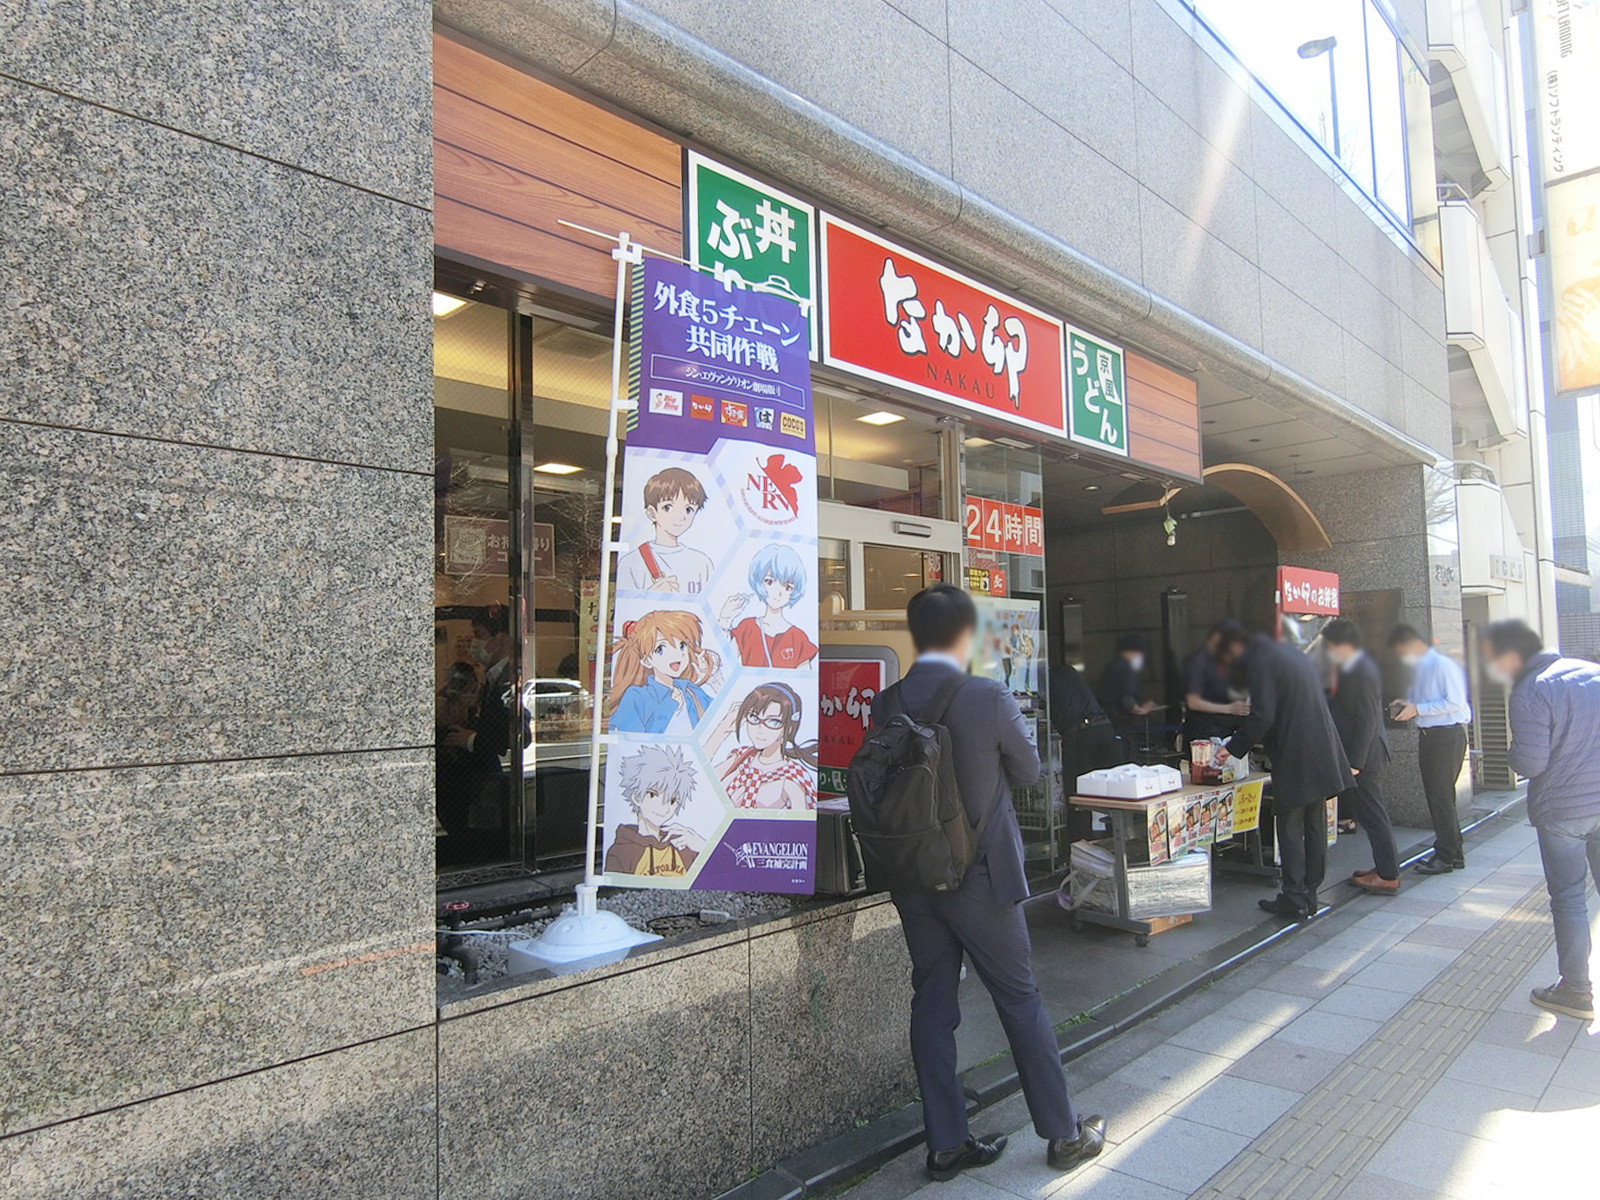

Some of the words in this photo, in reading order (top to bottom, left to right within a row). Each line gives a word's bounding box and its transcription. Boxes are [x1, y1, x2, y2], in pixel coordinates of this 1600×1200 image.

[1557, 14, 1573, 59] LANDING
[654, 281, 800, 346] 外食5チェーン
[879, 257, 1028, 410] なか卯
[686, 325, 779, 373] 共同作戦
[926, 362, 996, 400] NAKAU
[1072, 339, 1118, 445] うどん
[966, 505, 1043, 548] 24時間
[752, 842, 808, 856] EVANGELION
